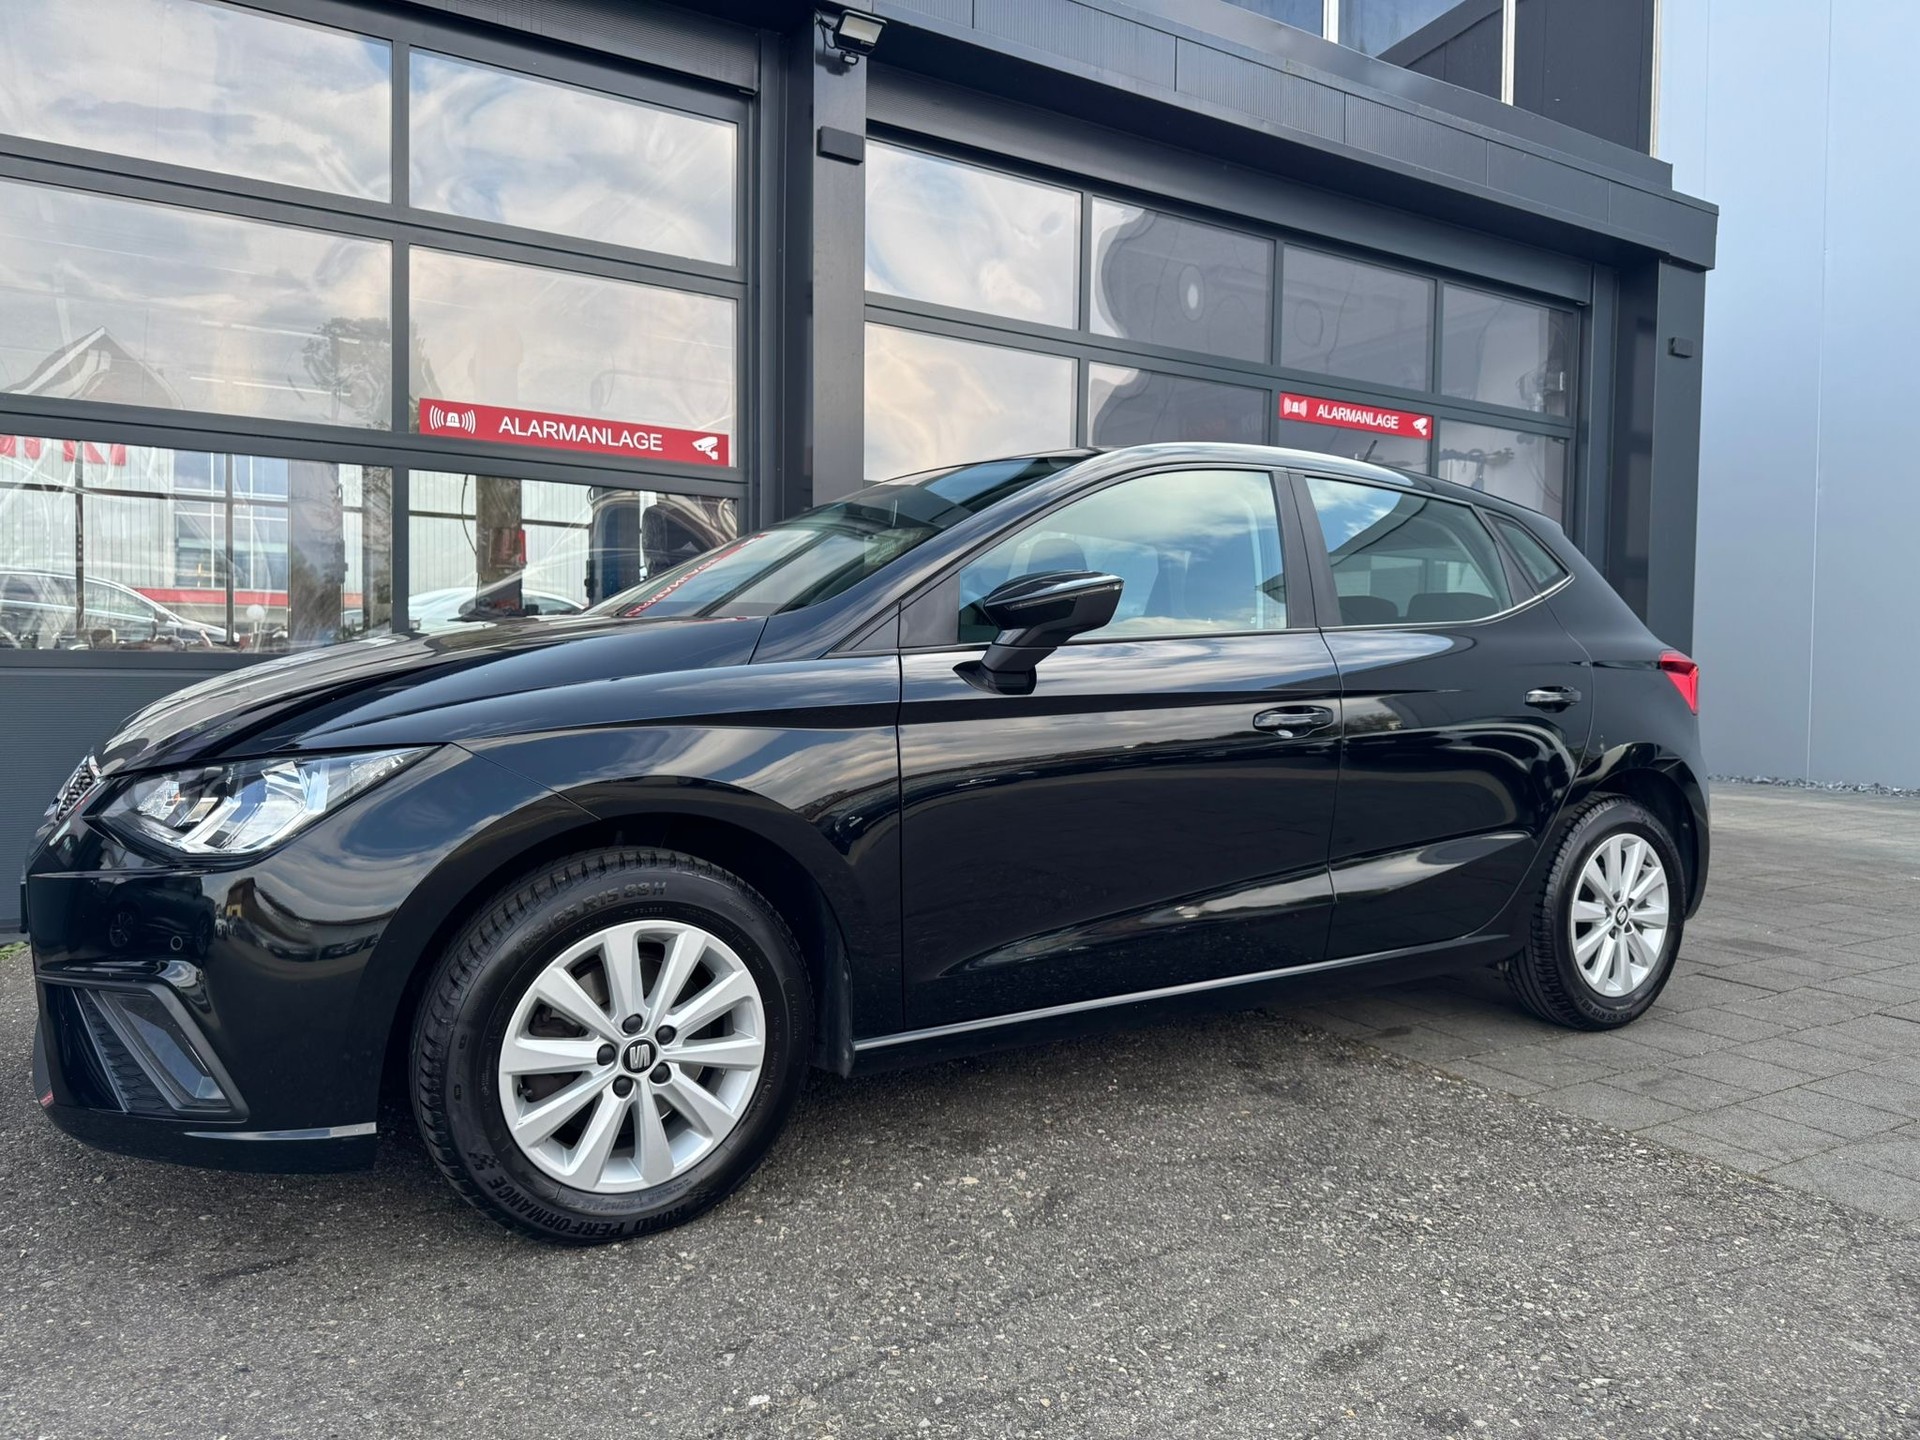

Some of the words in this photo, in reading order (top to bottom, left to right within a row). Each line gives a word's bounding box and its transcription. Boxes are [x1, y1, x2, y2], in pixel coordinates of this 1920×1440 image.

[498, 415, 664, 451] ALARMANLAGE
[1316, 404, 1399, 429] ALARMANLAGE
[485, 1175, 626, 1238] PERFORMANCE
